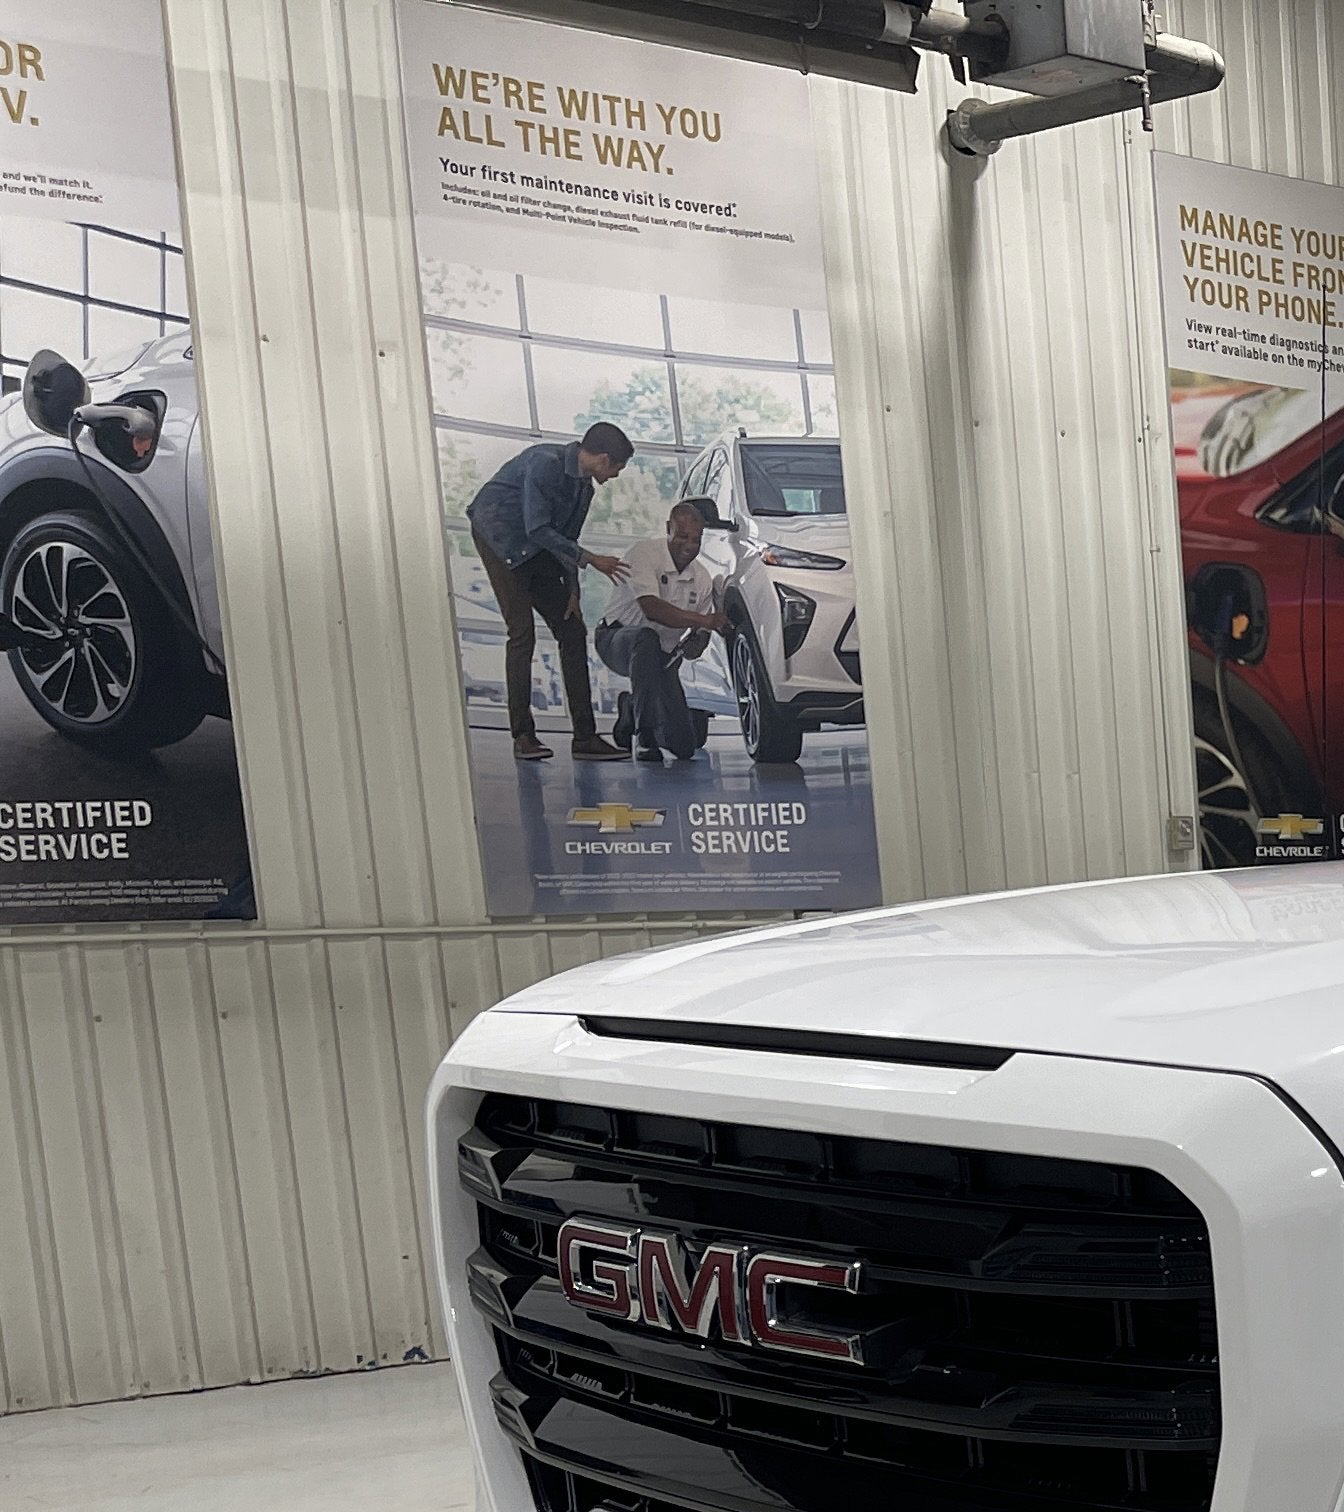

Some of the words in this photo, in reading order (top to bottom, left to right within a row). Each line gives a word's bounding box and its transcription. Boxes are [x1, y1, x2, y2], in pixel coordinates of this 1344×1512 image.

[432, 63, 547, 114] WE'RE
[556, 86, 646, 131] WITH
[656, 103, 721, 142] YOU
[437, 106, 505, 148] ALL
[514, 120, 583, 162] THE
[592, 133, 674, 175] WAY.
[3, 172, 21, 181] and
[23, 174, 46, 183] we'll
[49, 177, 80, 188] match
[29, 187, 46, 197] the
[439, 157, 476, 178] Your
[481, 165, 516, 185] first
[521, 174, 619, 201] maintenance
[623, 189, 654, 207] visit
[658, 193, 671, 208] is
[493, 191, 507, 201] and
[521, 195, 541, 207] filter
[575, 204, 599, 216] diesel
[632, 213, 649, 224] fluid
[651, 216, 668, 226] tank
[506, 206, 520, 215] and
[1179, 204, 1283, 251] MANAGE
[1181, 239, 1285, 285] VEHICLE
[1183, 274, 1250, 313] YOUR
[1257, 288, 1343, 329] PHONE.
[1186, 318, 1212, 334] View
[1216, 327, 1267, 344] real-time
[1270, 333, 1330, 354] diagnostics
[1222, 344, 1268, 360] available
[1272, 353, 1285, 364] on
[1287, 353, 1304, 367] the
[0, 801, 152, 829] CERTIFIED
[688, 802, 806, 826] CERTIFIED
[0, 832, 130, 862] SERVICE
[565, 841, 673, 855] CHEVROLET
[691, 830, 790, 853] SERVICE
[557, 1216, 864, 1367] GMC
